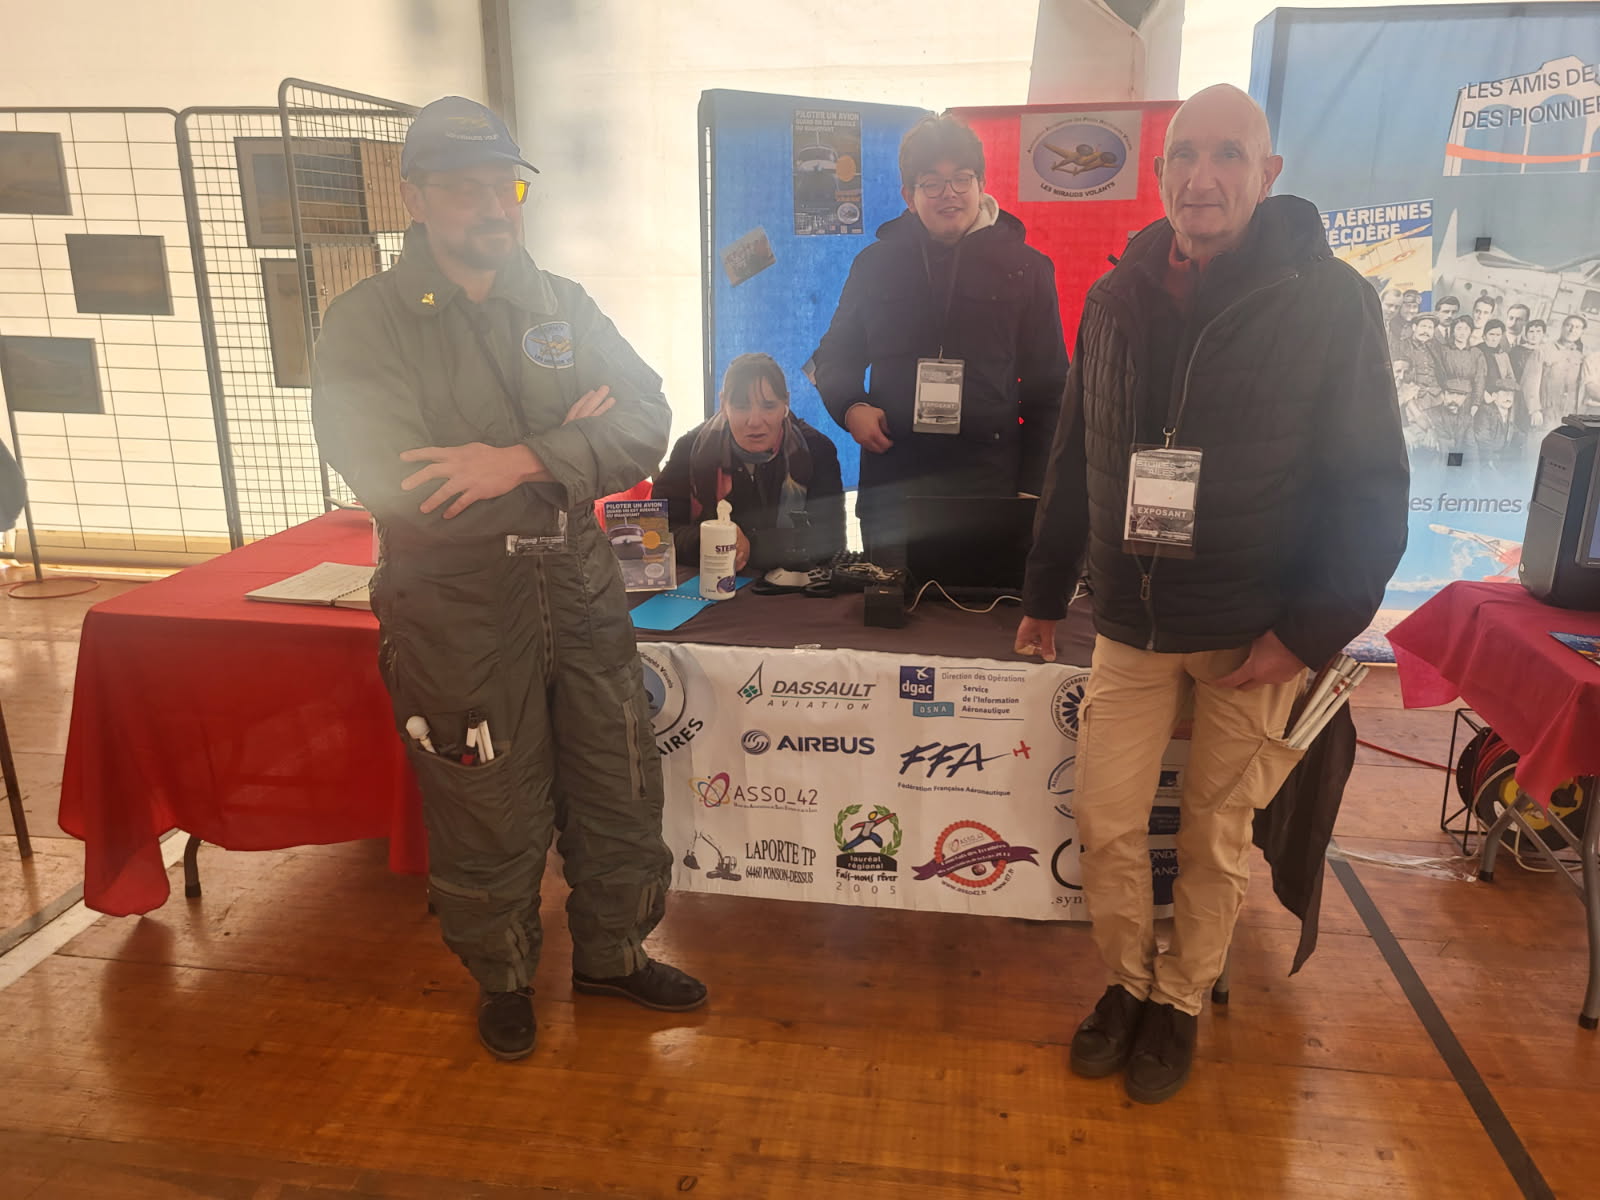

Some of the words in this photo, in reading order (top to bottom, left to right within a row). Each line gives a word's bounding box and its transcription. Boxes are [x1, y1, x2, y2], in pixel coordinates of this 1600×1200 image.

[1467, 80, 1503, 99] LES
[1509, 72, 1560, 95] AMIS
[1462, 110, 1503, 128] DES
[1321, 213, 1330, 229] S
[1334, 203, 1432, 229] AÉRIENNES
[1326, 224, 1401, 251] ÉCOÈRE
[1409, 497, 1432, 512] es
[1438, 493, 1522, 513] femmes
[1137, 507, 1187, 518] EXPOSANT
[942, 672, 972, 680] Direction
[974, 672, 986, 680] des
[987, 672, 1025, 683] Opérations
[772, 680, 877, 697] DASSAULT
[902, 680, 933, 696] dgac
[962, 685, 989, 693] Service
[767, 699, 869, 710] AVIATION
[961, 705, 1010, 715] Aéronautique
[656, 717, 704, 756] AIRES
[776, 735, 876, 755] AIRBUS
[899, 742, 1005, 778] FFA
[733, 785, 818, 805] ASSO_42
[897, 782, 932, 792] Fédération
[934, 784, 964, 793] Française
[965, 786, 1011, 797] Aéronautique
[745, 839, 799, 865] LAPORTE
[801, 846, 817, 866] TP
[746, 865, 763, 878] 64460
[836, 868, 874, 883] Fais-nous
[1153, 866, 1180, 876] ANC
[1051, 895, 1083, 908] .syn
